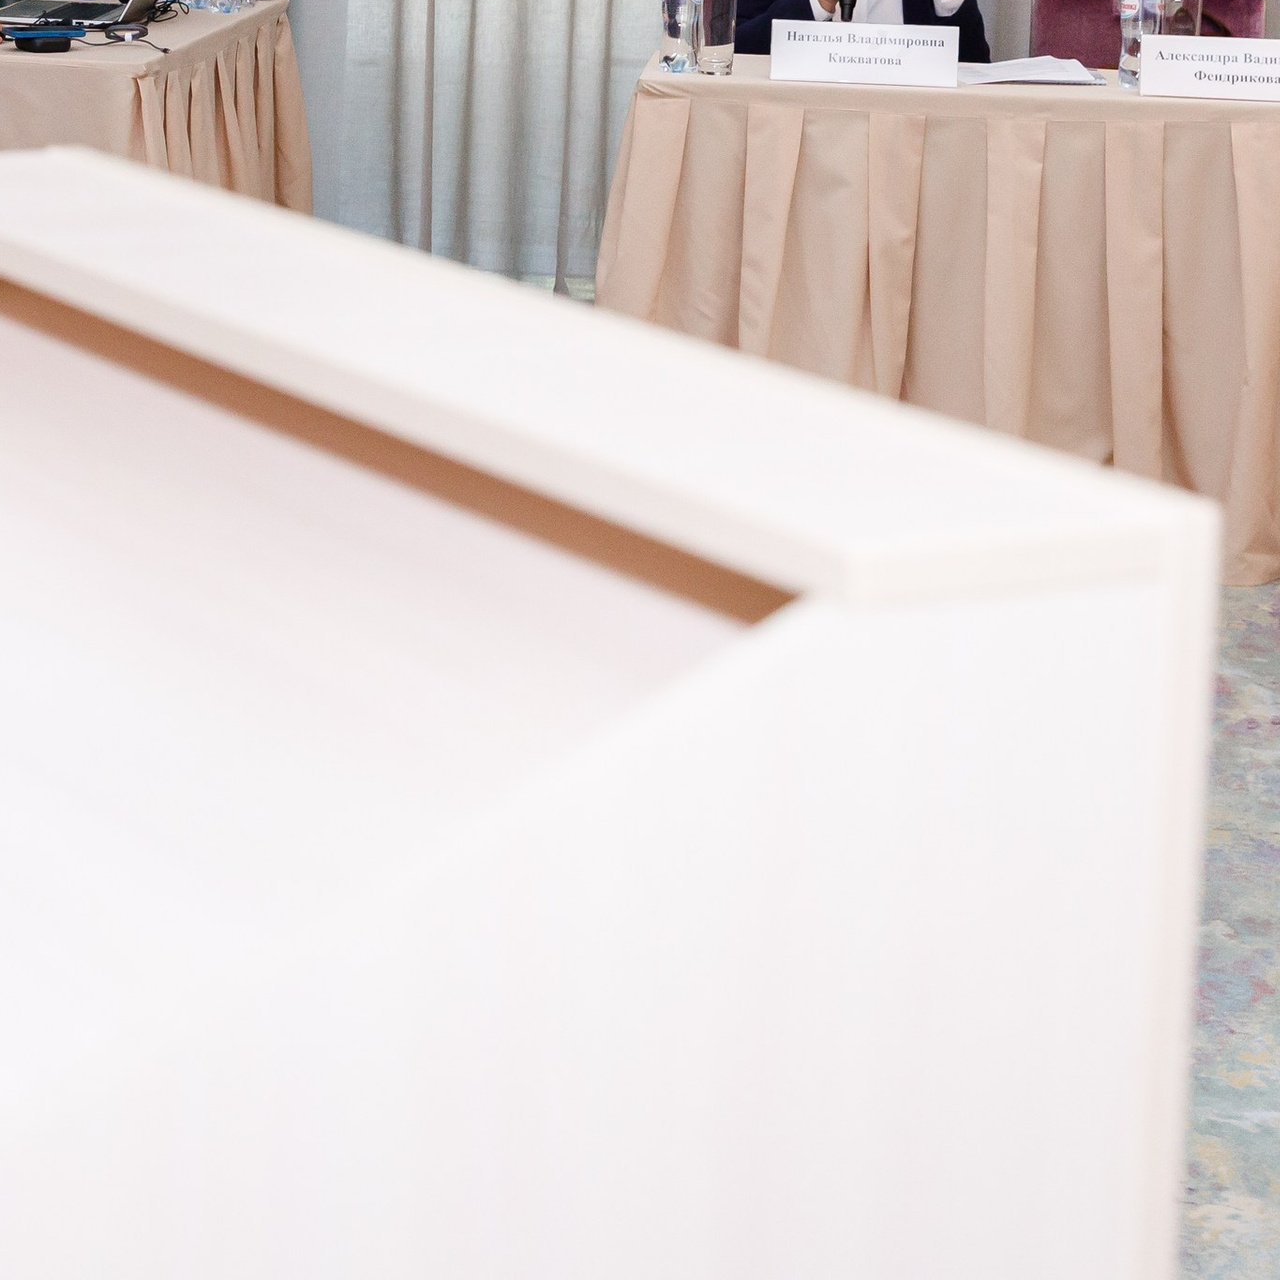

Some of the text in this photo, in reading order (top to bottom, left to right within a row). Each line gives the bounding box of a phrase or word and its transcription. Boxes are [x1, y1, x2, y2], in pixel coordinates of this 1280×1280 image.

[787, 31, 946, 49] Наталья Владимировна
[828, 52, 902, 66] Кижватова
[1155, 50, 1280, 65] Александра Вади
[1194, 70, 1280, 85] Фендрикова
